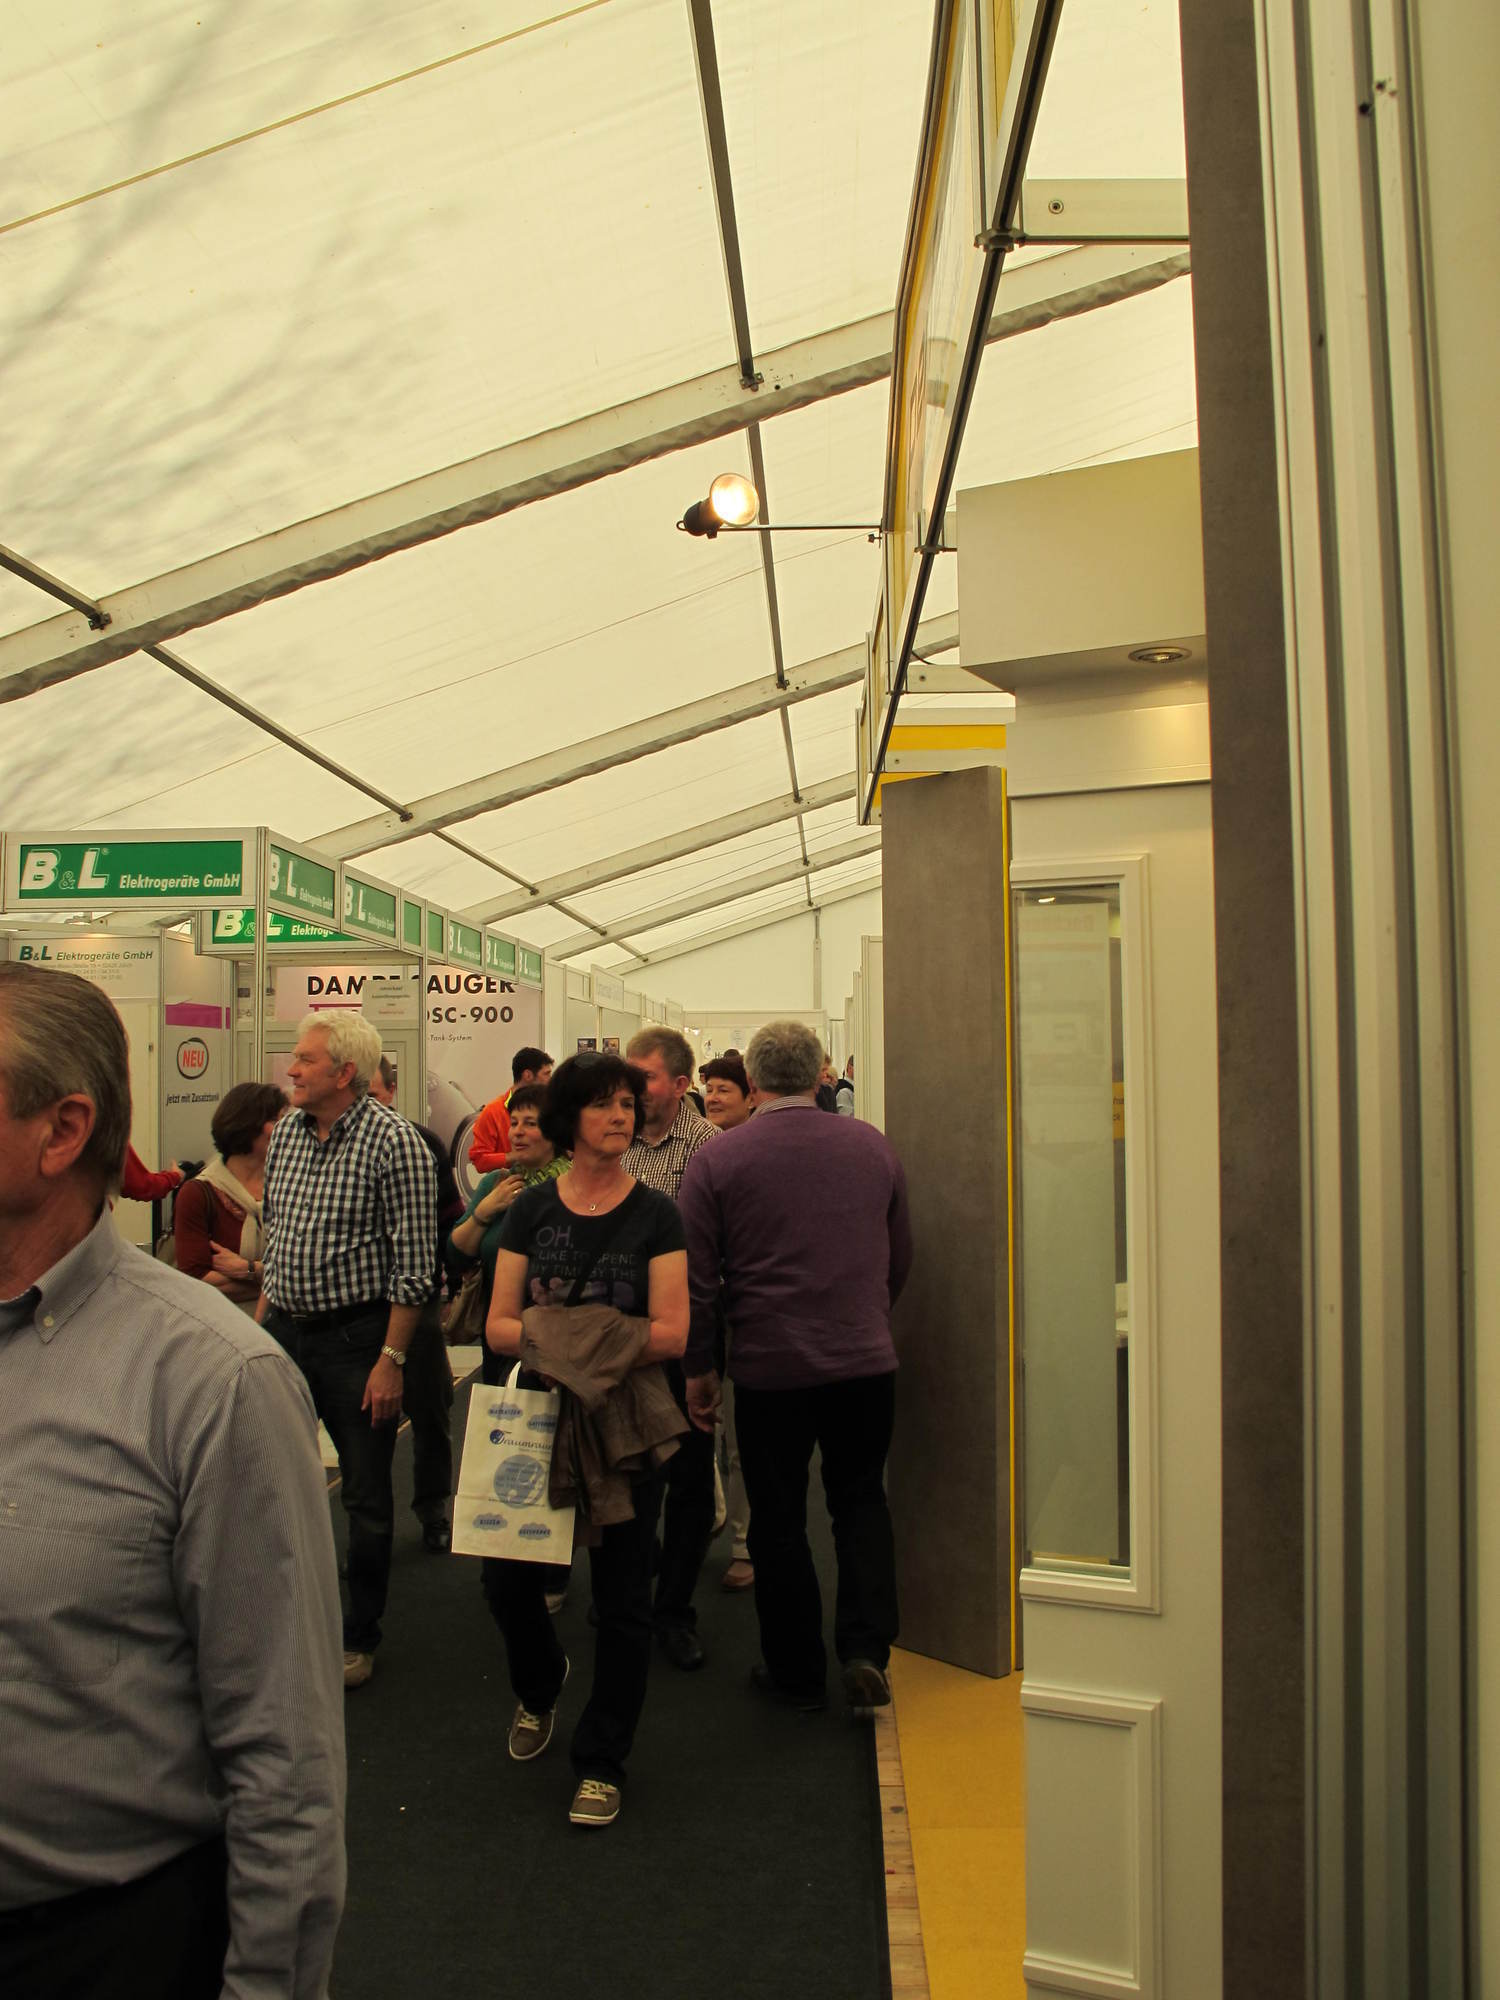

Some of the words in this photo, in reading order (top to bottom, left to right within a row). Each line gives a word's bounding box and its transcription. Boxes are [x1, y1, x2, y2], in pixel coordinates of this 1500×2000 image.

[119, 874, 200, 891] Elektrogeräte
[203, 873, 241, 888] GmbH
[56, 951, 121, 963] Elektrogeräte
[122, 951, 154, 960] GmbH
[182, 1050, 205, 1068] NEU
